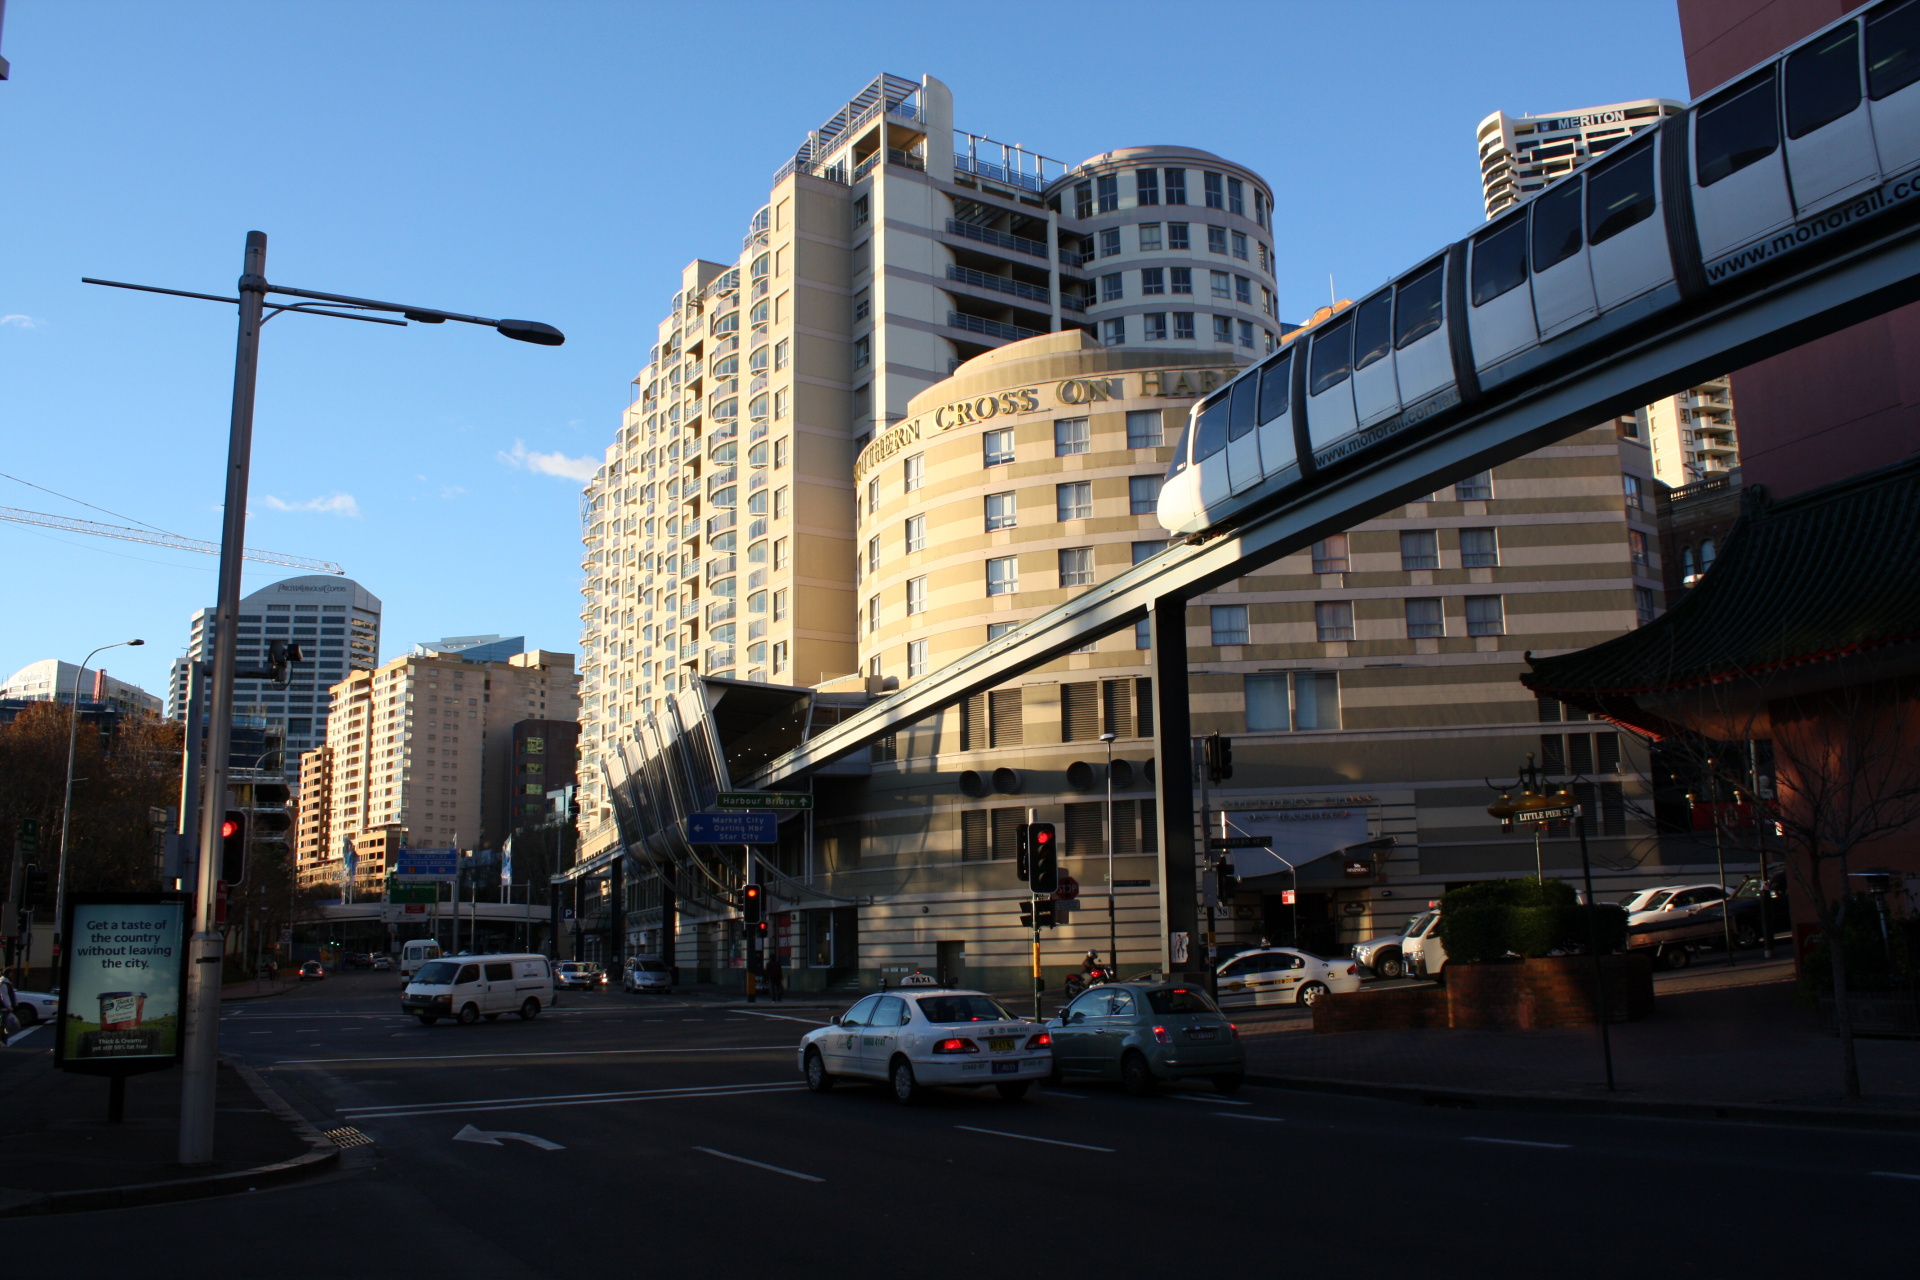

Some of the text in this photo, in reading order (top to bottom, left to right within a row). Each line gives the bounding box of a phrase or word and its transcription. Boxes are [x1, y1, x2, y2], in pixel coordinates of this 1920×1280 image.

[1557, 110, 1626, 130] MERITON
[935, 388, 1034, 432] CROSS
[1056, 377, 1110, 405] ON
[722, 797, 796, 807] Harbour Bridge
[1518, 811, 1545, 821] LITTLE
[1545, 809, 1562, 819] PIER
[746, 817, 765, 825] City
[714, 824, 764, 832] Darling Hbr
[719, 833, 760, 841] Star City
[1057, 884, 1077, 894] STOP
[565, 908, 573, 918] P
[87, 919, 167, 931] Get a taste of
[91, 933, 161, 945] the country
[77, 945, 172, 957] without leaving
[102, 958, 150, 970] the city.
[909, 976, 931, 984] TAXI
[120, 1038, 143, 1046] Creamy
